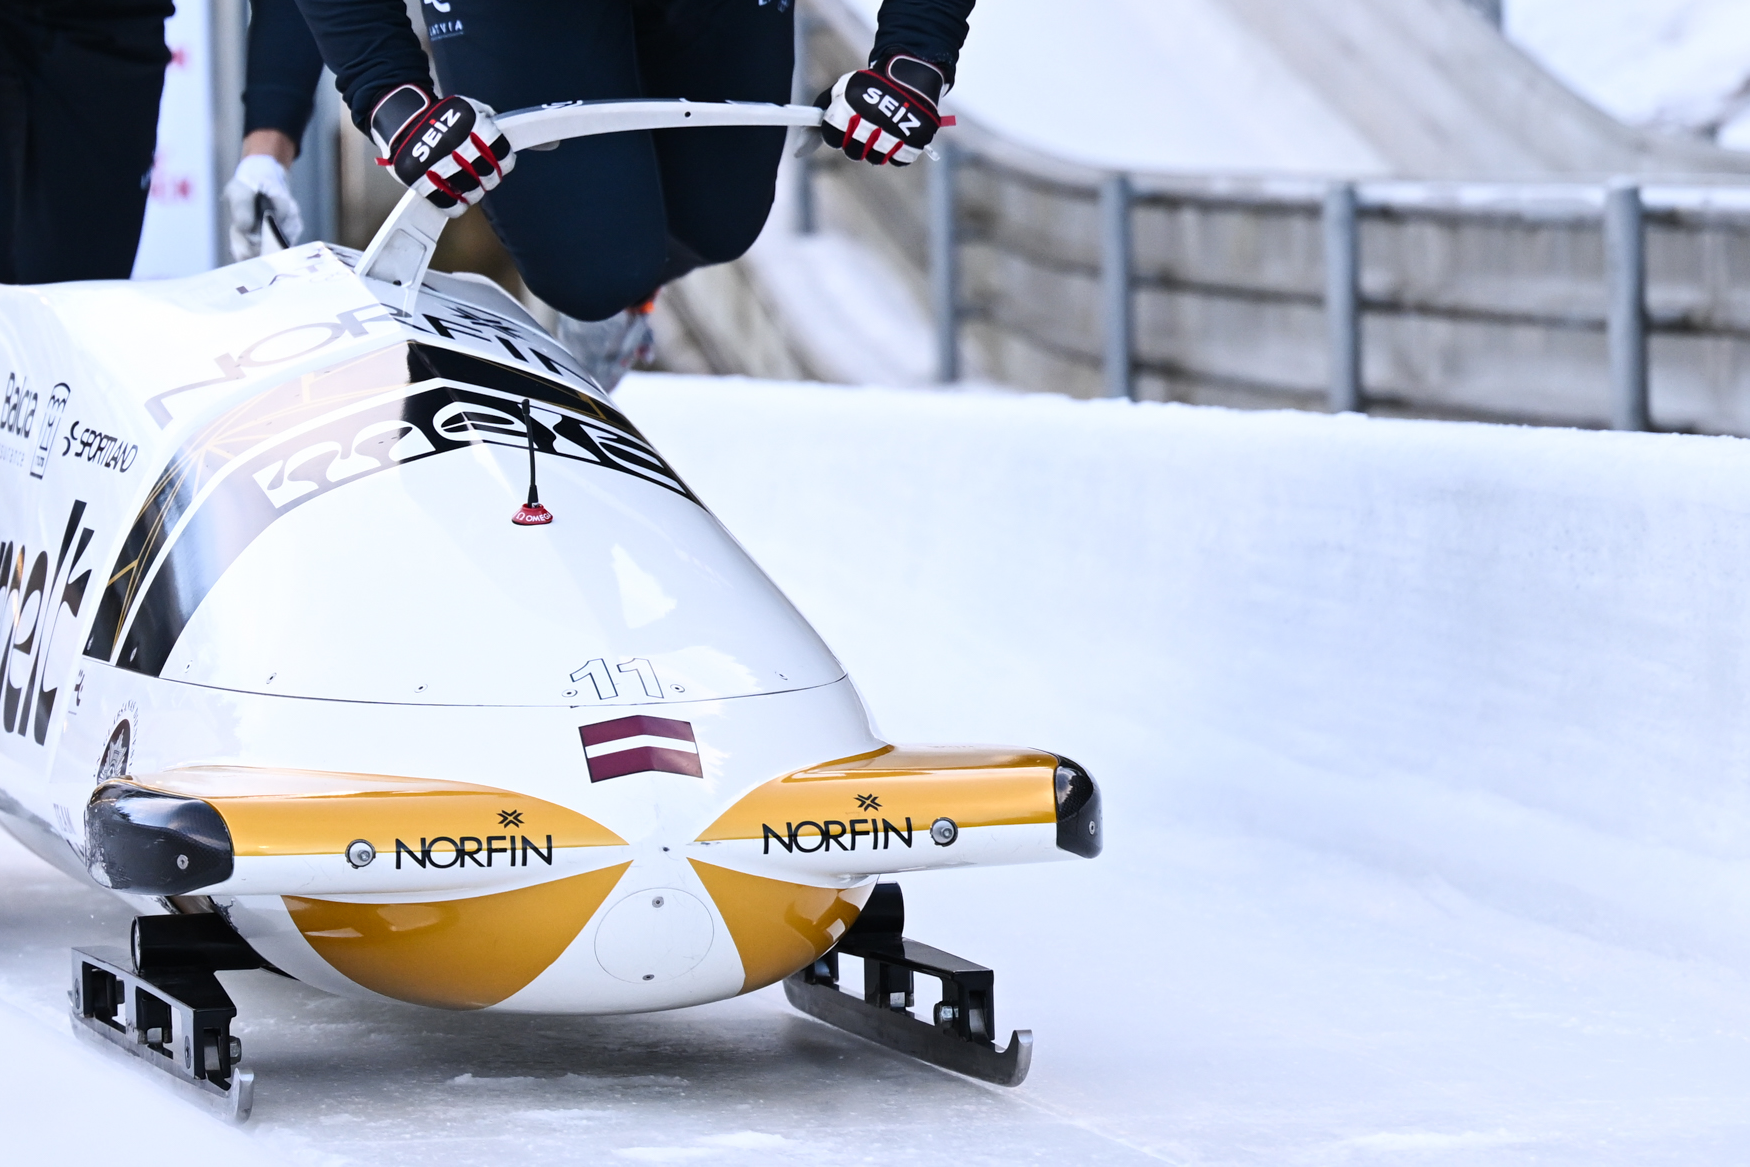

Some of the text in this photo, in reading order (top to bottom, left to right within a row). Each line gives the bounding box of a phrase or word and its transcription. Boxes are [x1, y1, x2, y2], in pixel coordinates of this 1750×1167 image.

[0, 371, 39, 439] Balcia
[74, 428, 139, 474] SPORTLAND
[570, 657, 664, 700] 11
[395, 833, 554, 870] NORFIN
[761, 816, 913, 856] NORFIN
